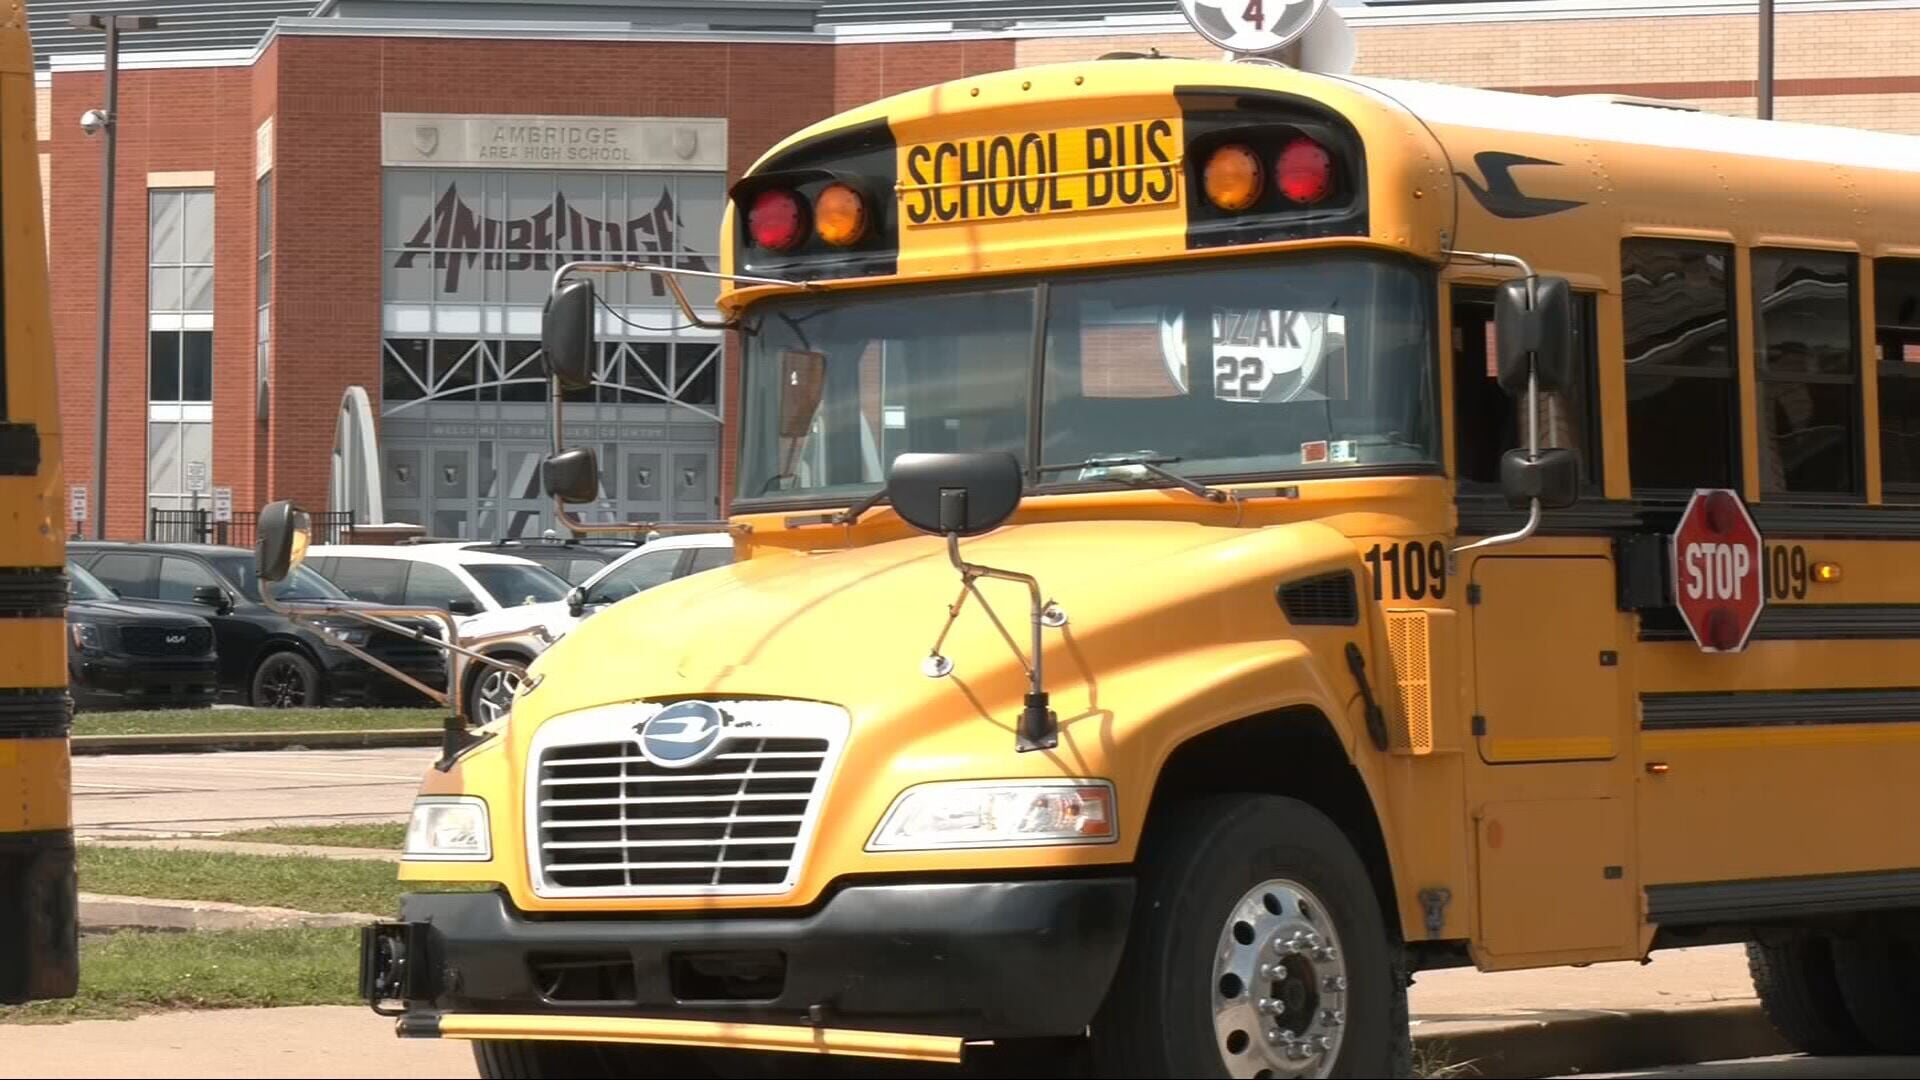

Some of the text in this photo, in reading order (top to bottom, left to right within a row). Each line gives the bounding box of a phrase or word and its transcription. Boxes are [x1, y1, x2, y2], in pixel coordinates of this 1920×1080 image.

[1241, 0, 1265, 31] 4
[479, 146, 631, 161] AREA HIGH SCHOOL
[493, 126, 618, 145] AMBRIDGE
[906, 119, 1174, 224] SCHOOL BUS
[394, 180, 712, 297] AMBRIDGE
[1215, 355, 1264, 398] 22
[1364, 540, 1446, 601] 1109
[1685, 542, 1750, 600] STOP
